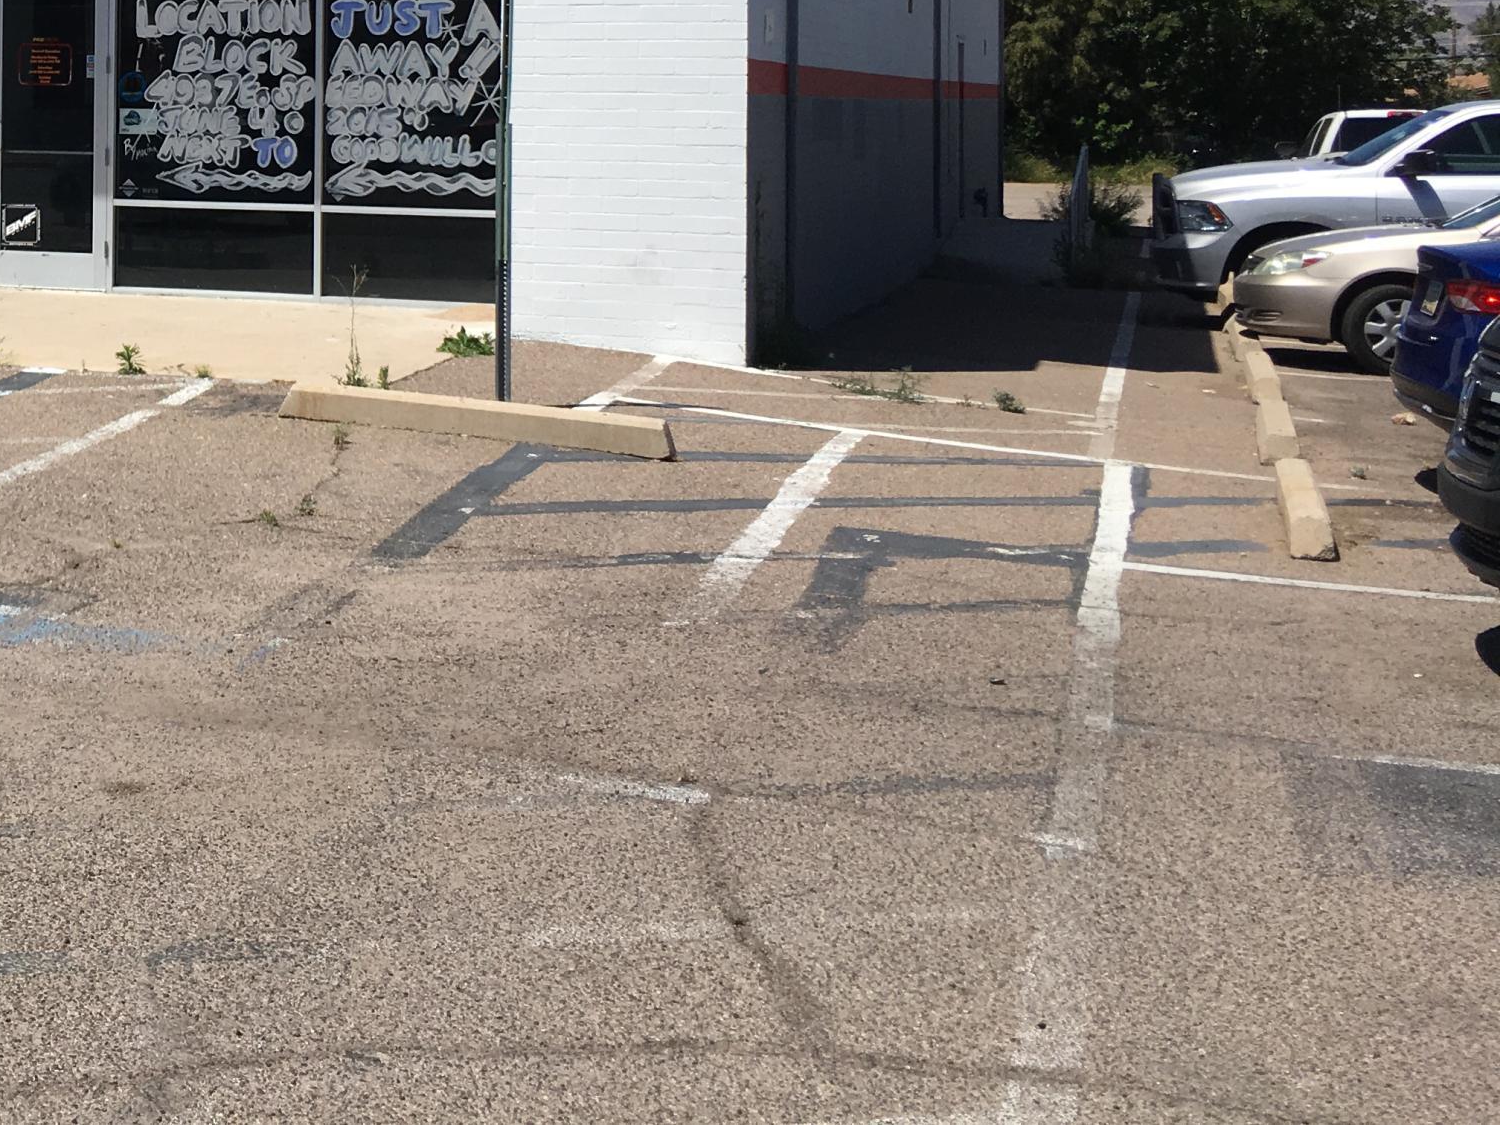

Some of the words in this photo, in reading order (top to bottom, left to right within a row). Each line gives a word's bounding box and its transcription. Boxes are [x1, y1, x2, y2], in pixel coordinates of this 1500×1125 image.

[172, 34, 307, 76] BLOCK
[157, 105, 241, 136] JUNE
[157, 134, 251, 169] NEXT
[252, 136, 297, 168] TO
